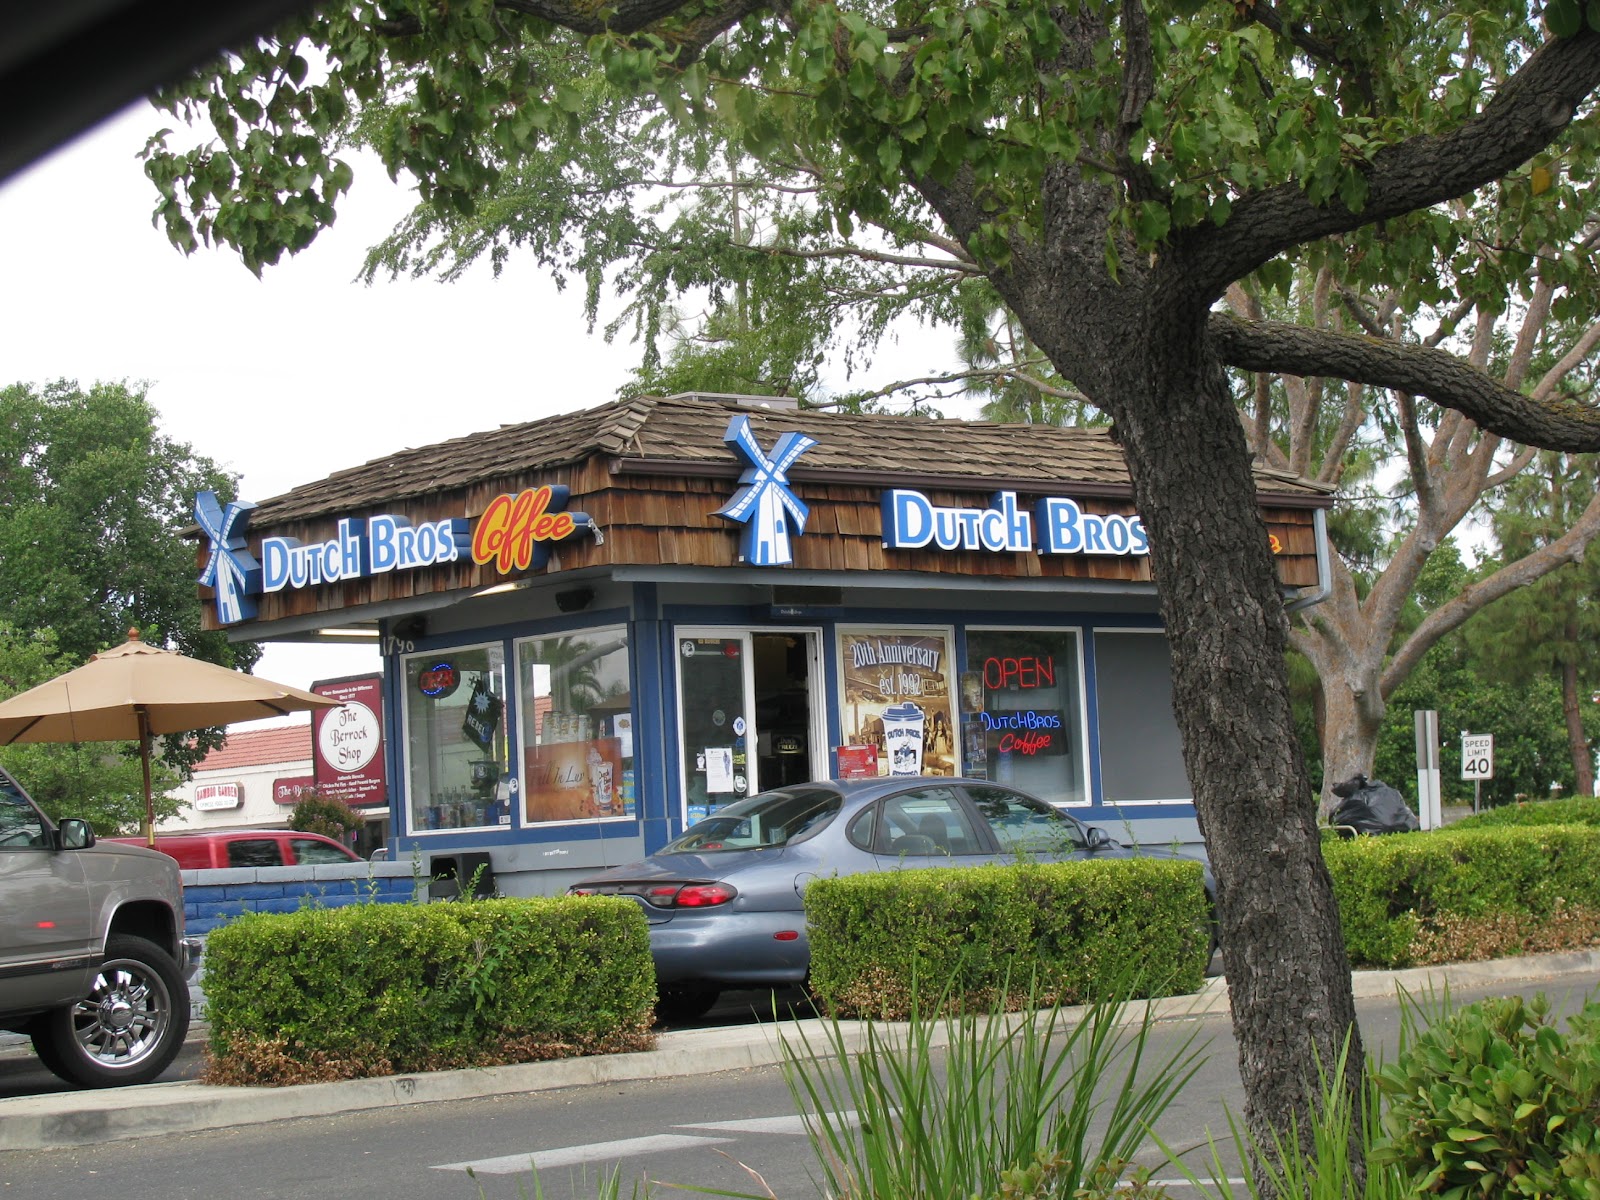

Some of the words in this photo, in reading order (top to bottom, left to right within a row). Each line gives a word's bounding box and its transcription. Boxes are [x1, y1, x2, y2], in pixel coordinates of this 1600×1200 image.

[893, 488, 1032, 552] DUTCH
[262, 518, 361, 593] DUTCH
[472, 484, 576, 575] Coffee
[383, 635, 414, 656] 1790
[849, 641, 877, 669] 20th
[877, 639, 940, 672] Anniversary
[984, 656, 1054, 690] OPEN
[880, 675, 897, 695] est.
[898, 673, 922, 696] 1992
[339, 708, 357, 727] The
[466, 714, 485, 737] REBEL
[330, 725, 368, 747] Berrock
[887, 728, 904, 740] DUTCH
[999, 732, 1052, 756] Coffee
[1464, 740, 1490, 748] SPEED
[338, 747, 361, 765] Shop
[1467, 748, 1487, 757] LIMIT
[1464, 758, 1489, 774] 40
[196, 786, 216, 801] BAMBOO
[217, 785, 238, 798] GARDEN
[277, 785, 292, 798] The
